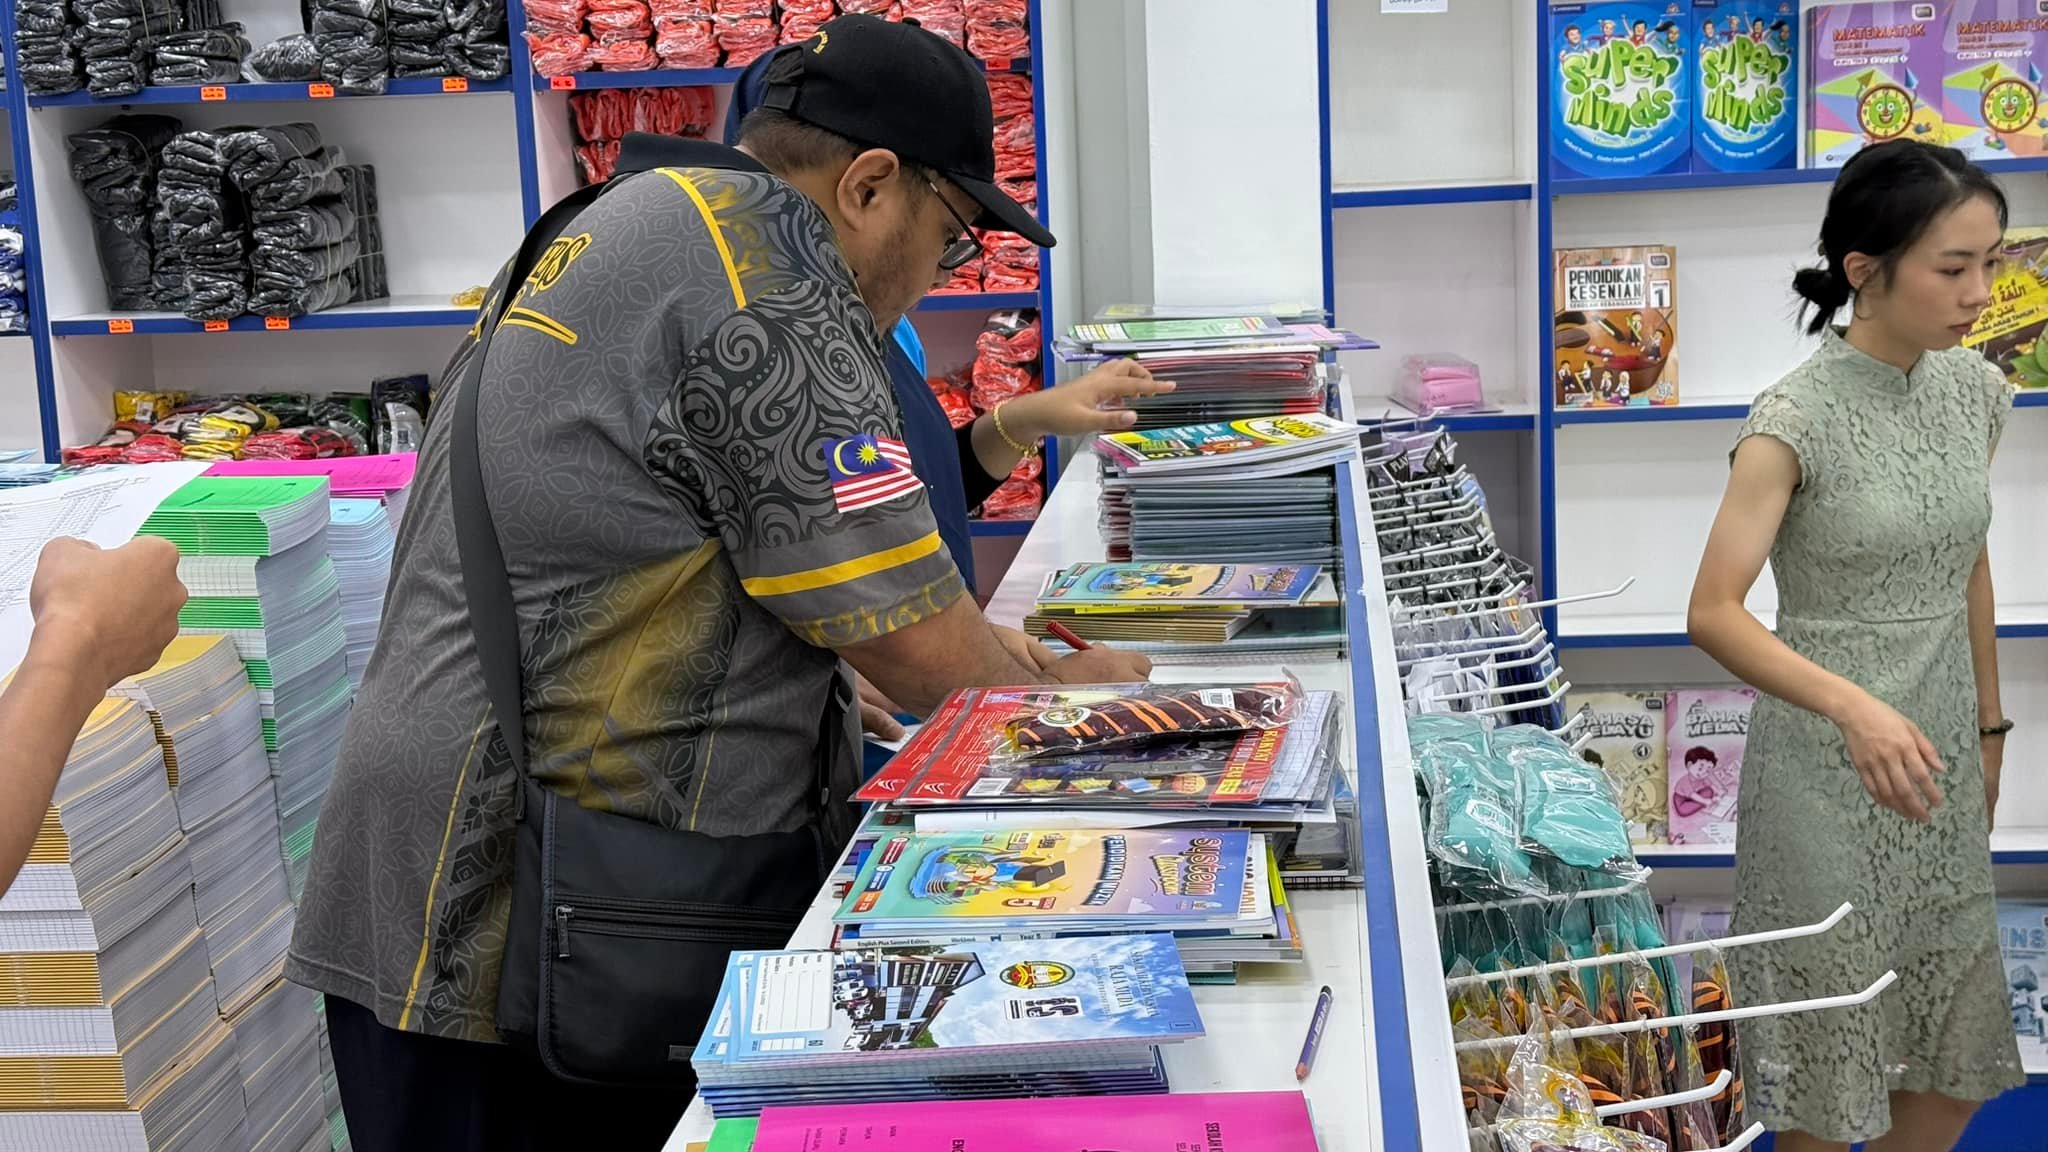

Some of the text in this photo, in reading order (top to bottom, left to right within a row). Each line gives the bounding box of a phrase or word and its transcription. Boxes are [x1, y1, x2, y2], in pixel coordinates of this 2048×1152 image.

[1832, 24, 1926, 42] MATEMATIK
[1563, 39, 1679, 95] Super
[1702, 35, 1790, 89] Super
[1567, 84, 1674, 137] Minds
[1702, 80, 1785, 133] Minds
[1569, 268, 1641, 285] PENDIDIKAN
[1569, 284, 1641, 300] KESENIAN
[1654, 288, 1664, 307] 1
[1686, 709, 1750, 724] BAHAS
[1686, 722, 1748, 738] MELAY
[1253, 730, 1278, 761] RAKYAT
[1088, 835, 1127, 906] PENDIDIKAN MUZIK
[1184, 838, 1224, 896] system
[2000, 928, 2046, 949] INS
[1108, 964, 1134, 1009] RAJA MUDA
[1206, 1122, 1222, 1147] SEKOLAH
